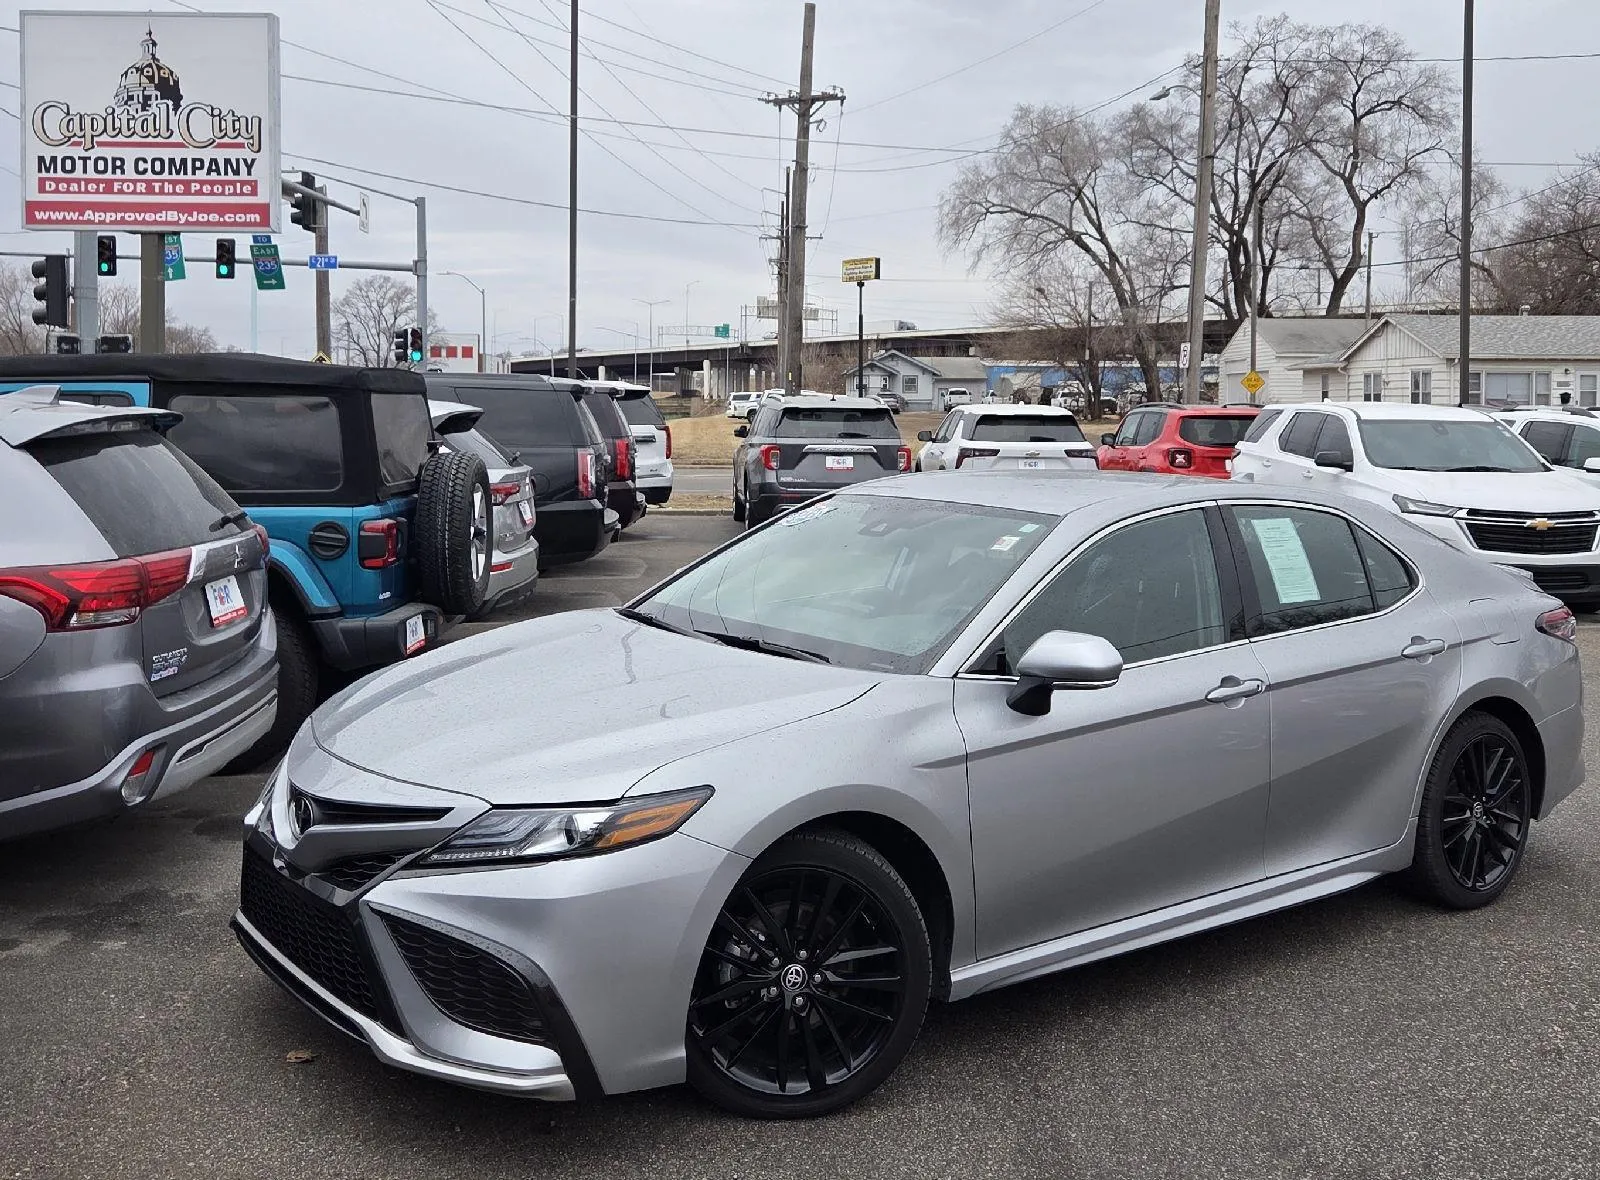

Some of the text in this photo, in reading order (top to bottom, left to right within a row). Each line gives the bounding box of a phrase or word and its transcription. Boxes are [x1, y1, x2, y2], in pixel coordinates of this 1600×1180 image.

[32, 100, 262, 153] Capital City
[37, 155, 257, 176] MOTOR COMPANY
[45, 180, 252, 195] Dealer FOR The People
[34, 209, 261, 224] www.ApprovedByJoe.com
[253, 247, 276, 255] EAST
[258, 260, 278, 270] 235
